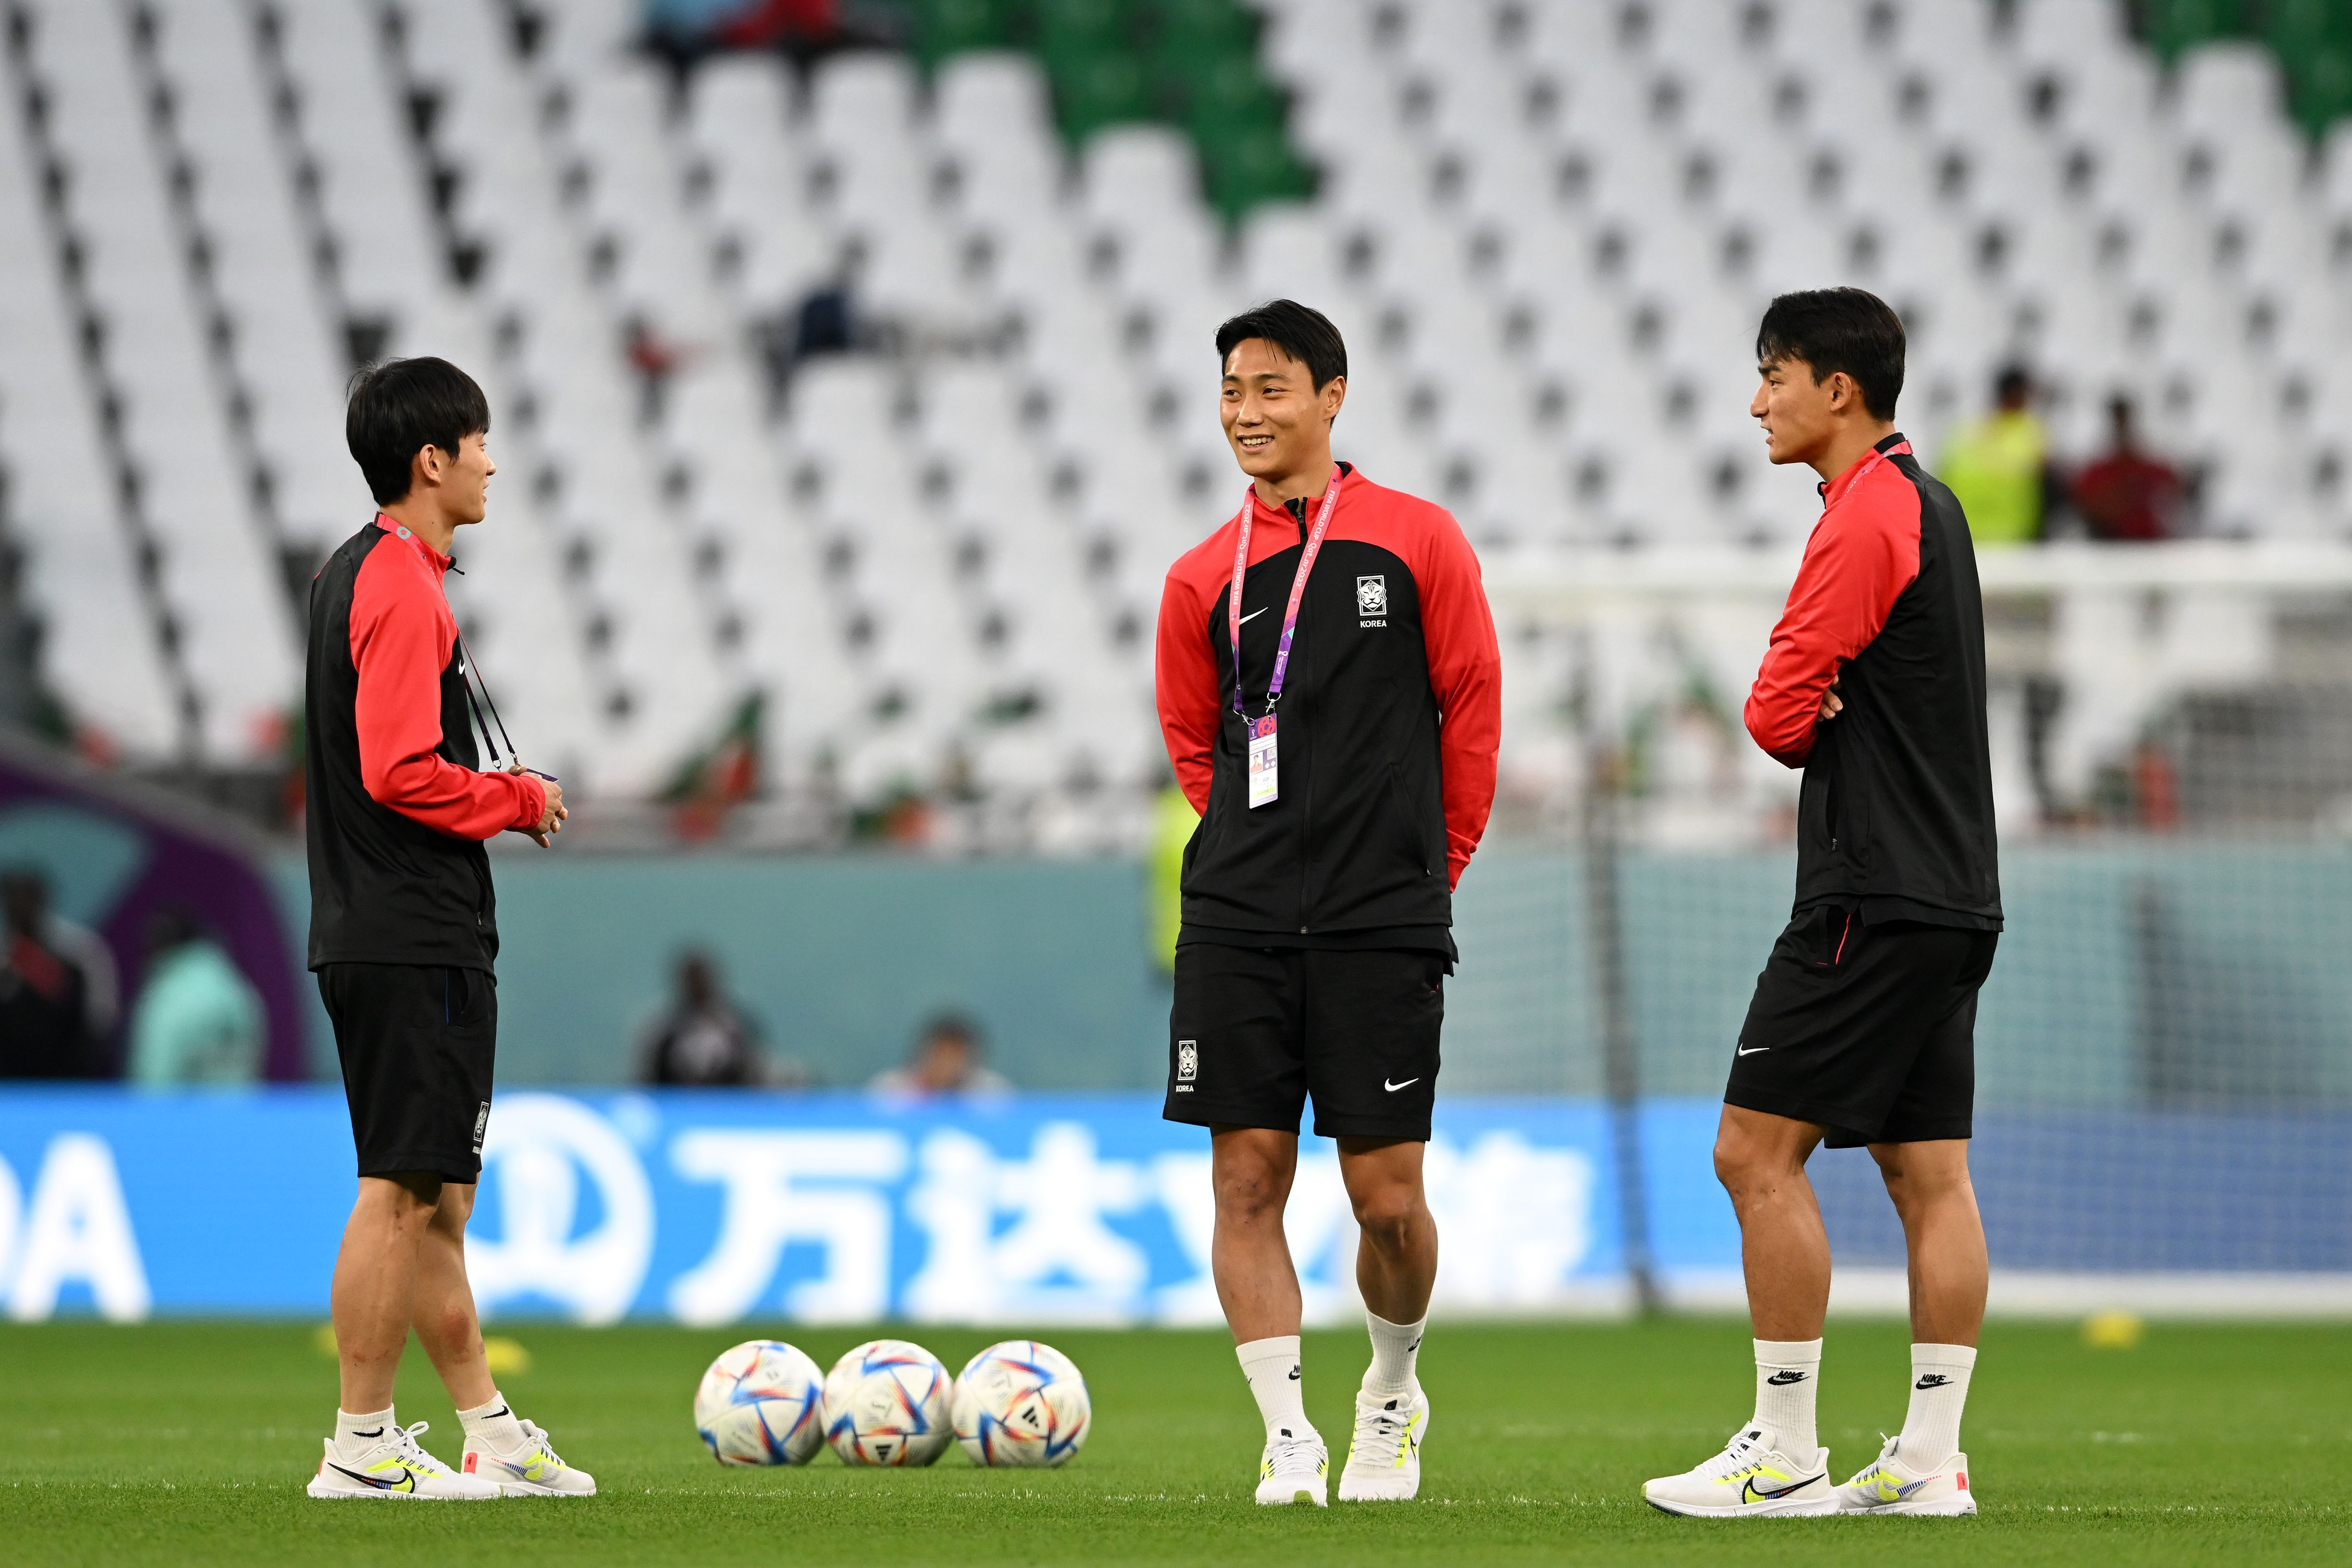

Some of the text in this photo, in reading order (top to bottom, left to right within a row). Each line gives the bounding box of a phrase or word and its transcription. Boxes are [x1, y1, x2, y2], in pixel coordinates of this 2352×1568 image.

[1326, 490, 1335, 504] FIFA
[1318, 504, 1331, 527] WORLD
[1360, 619, 1387, 628] KOREA
[1921, 1373, 1947, 1384] NIKE
